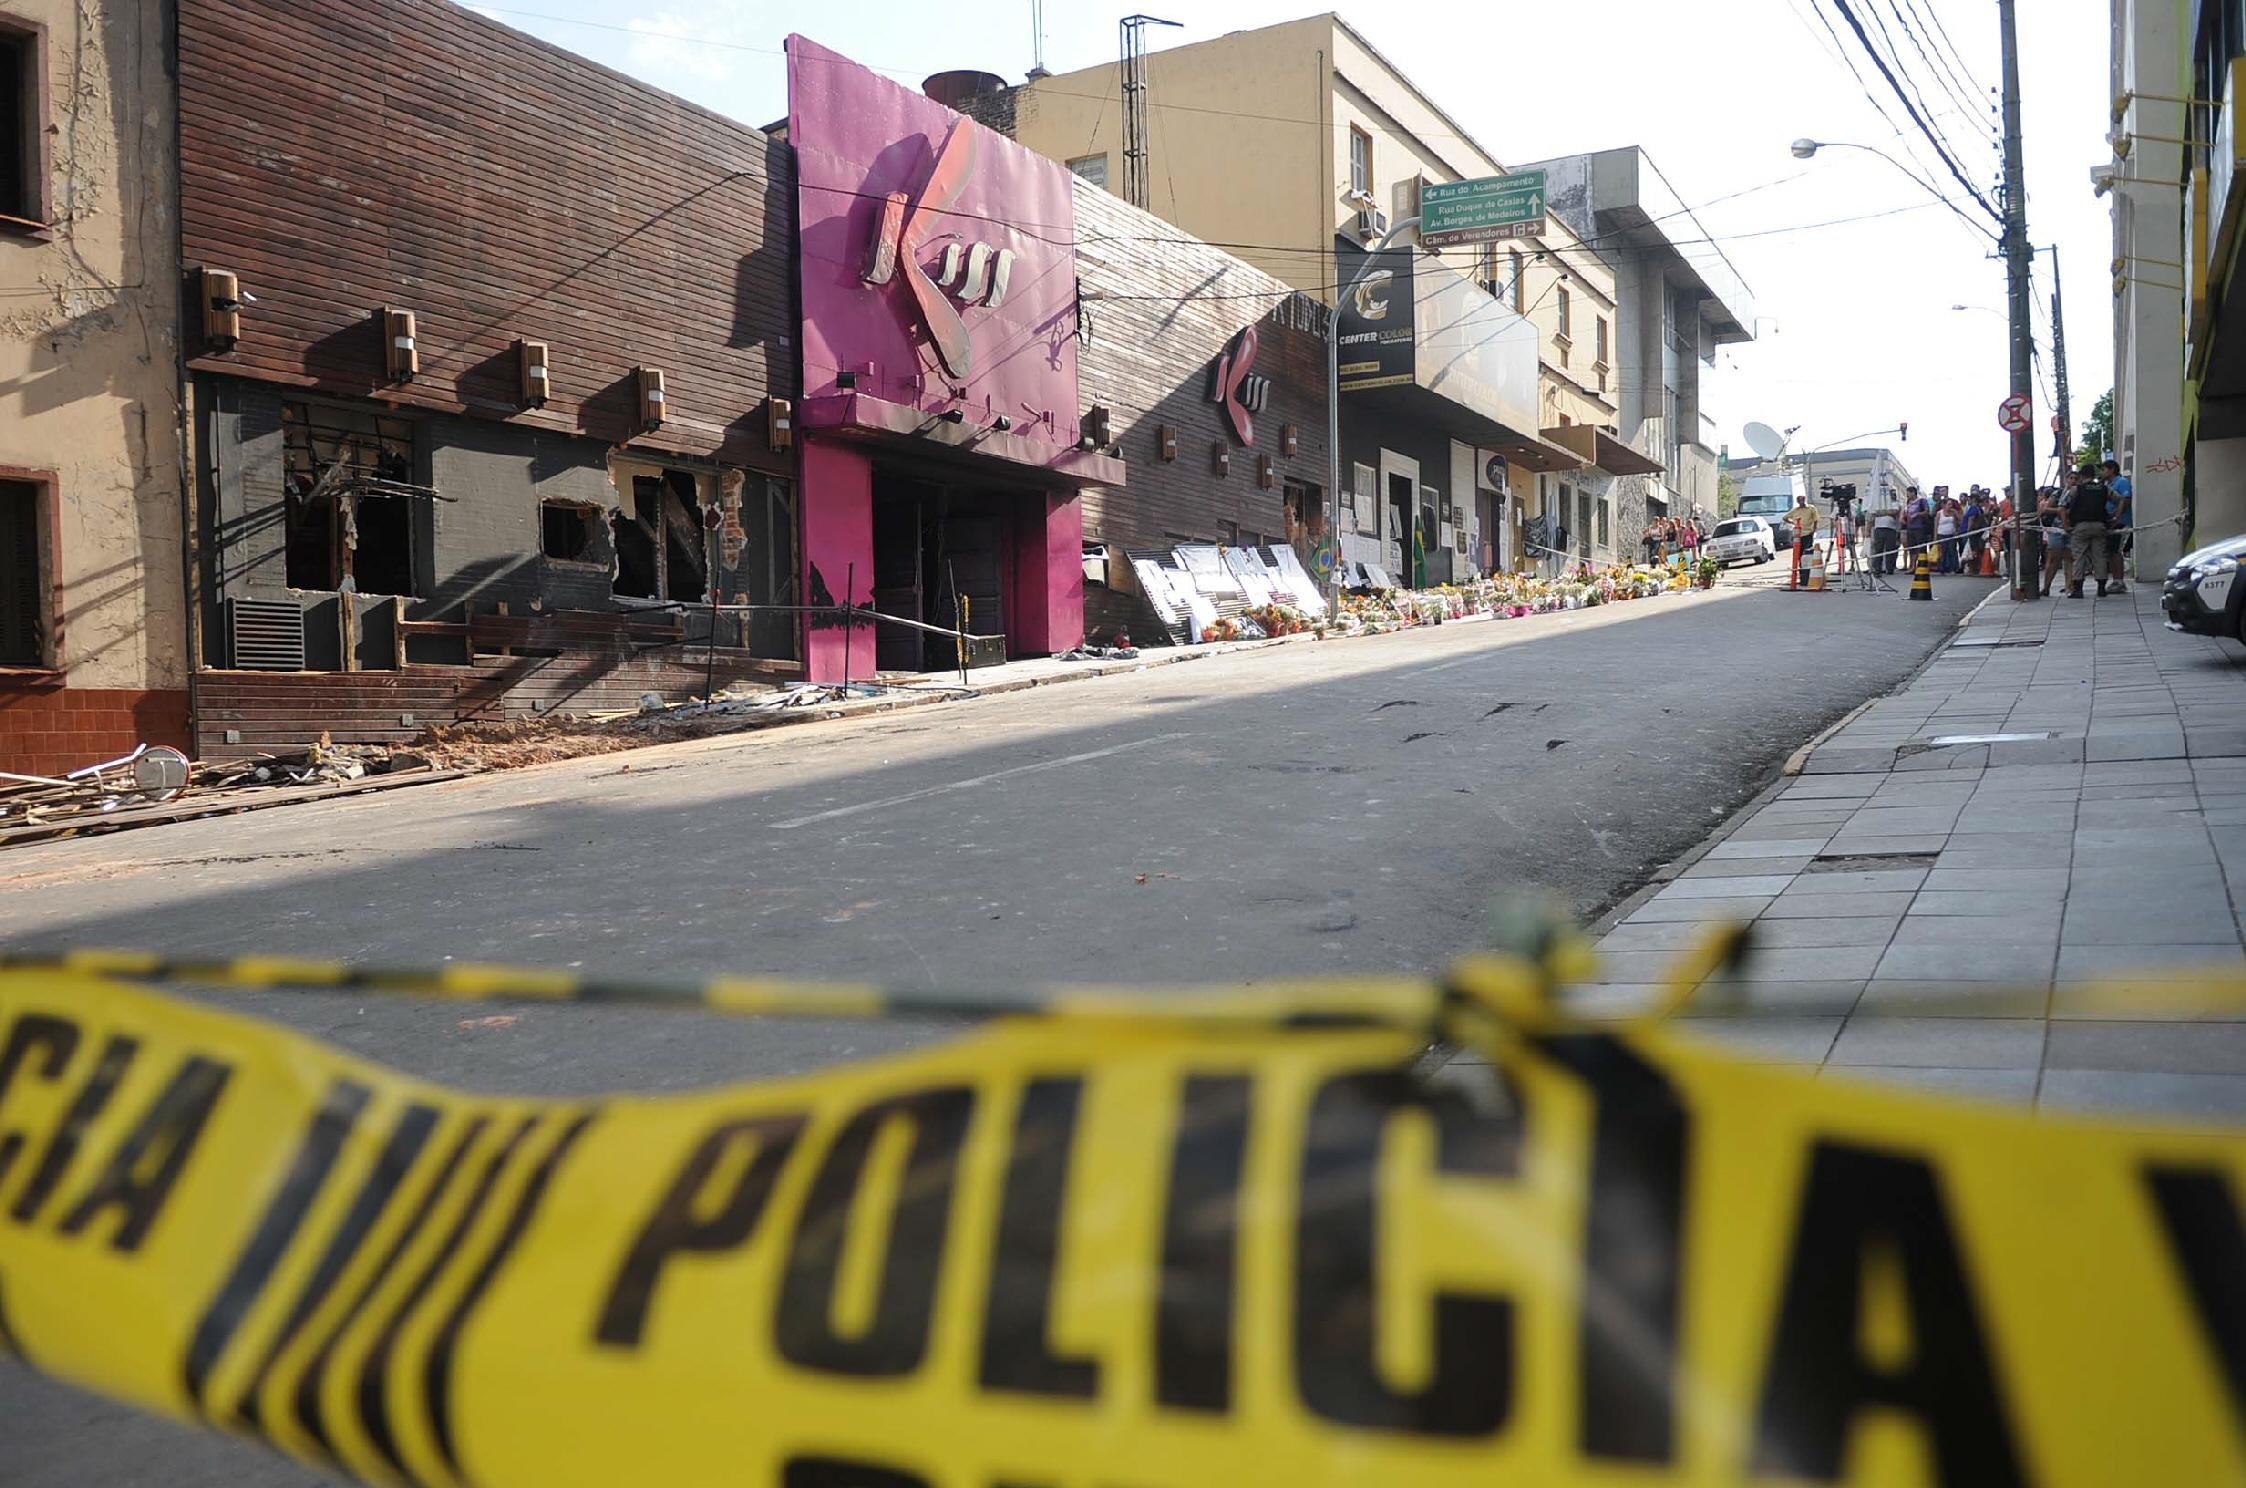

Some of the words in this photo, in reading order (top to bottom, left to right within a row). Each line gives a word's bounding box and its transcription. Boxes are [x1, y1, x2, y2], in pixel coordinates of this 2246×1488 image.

[1440, 188, 1455, 197] Rua
[1457, 186, 1469, 195] do
[1473, 176, 1535, 192] Acampamento
[1430, 219, 1443, 228] Av.
[1444, 214, 1473, 227] Borges
[1487, 208, 1526, 219] Medeiros
[1439, 206, 1455, 215] Rua
[1339, 331, 1378, 345] CENTER
[590, 1034, 2040, 1488] POLICIA
